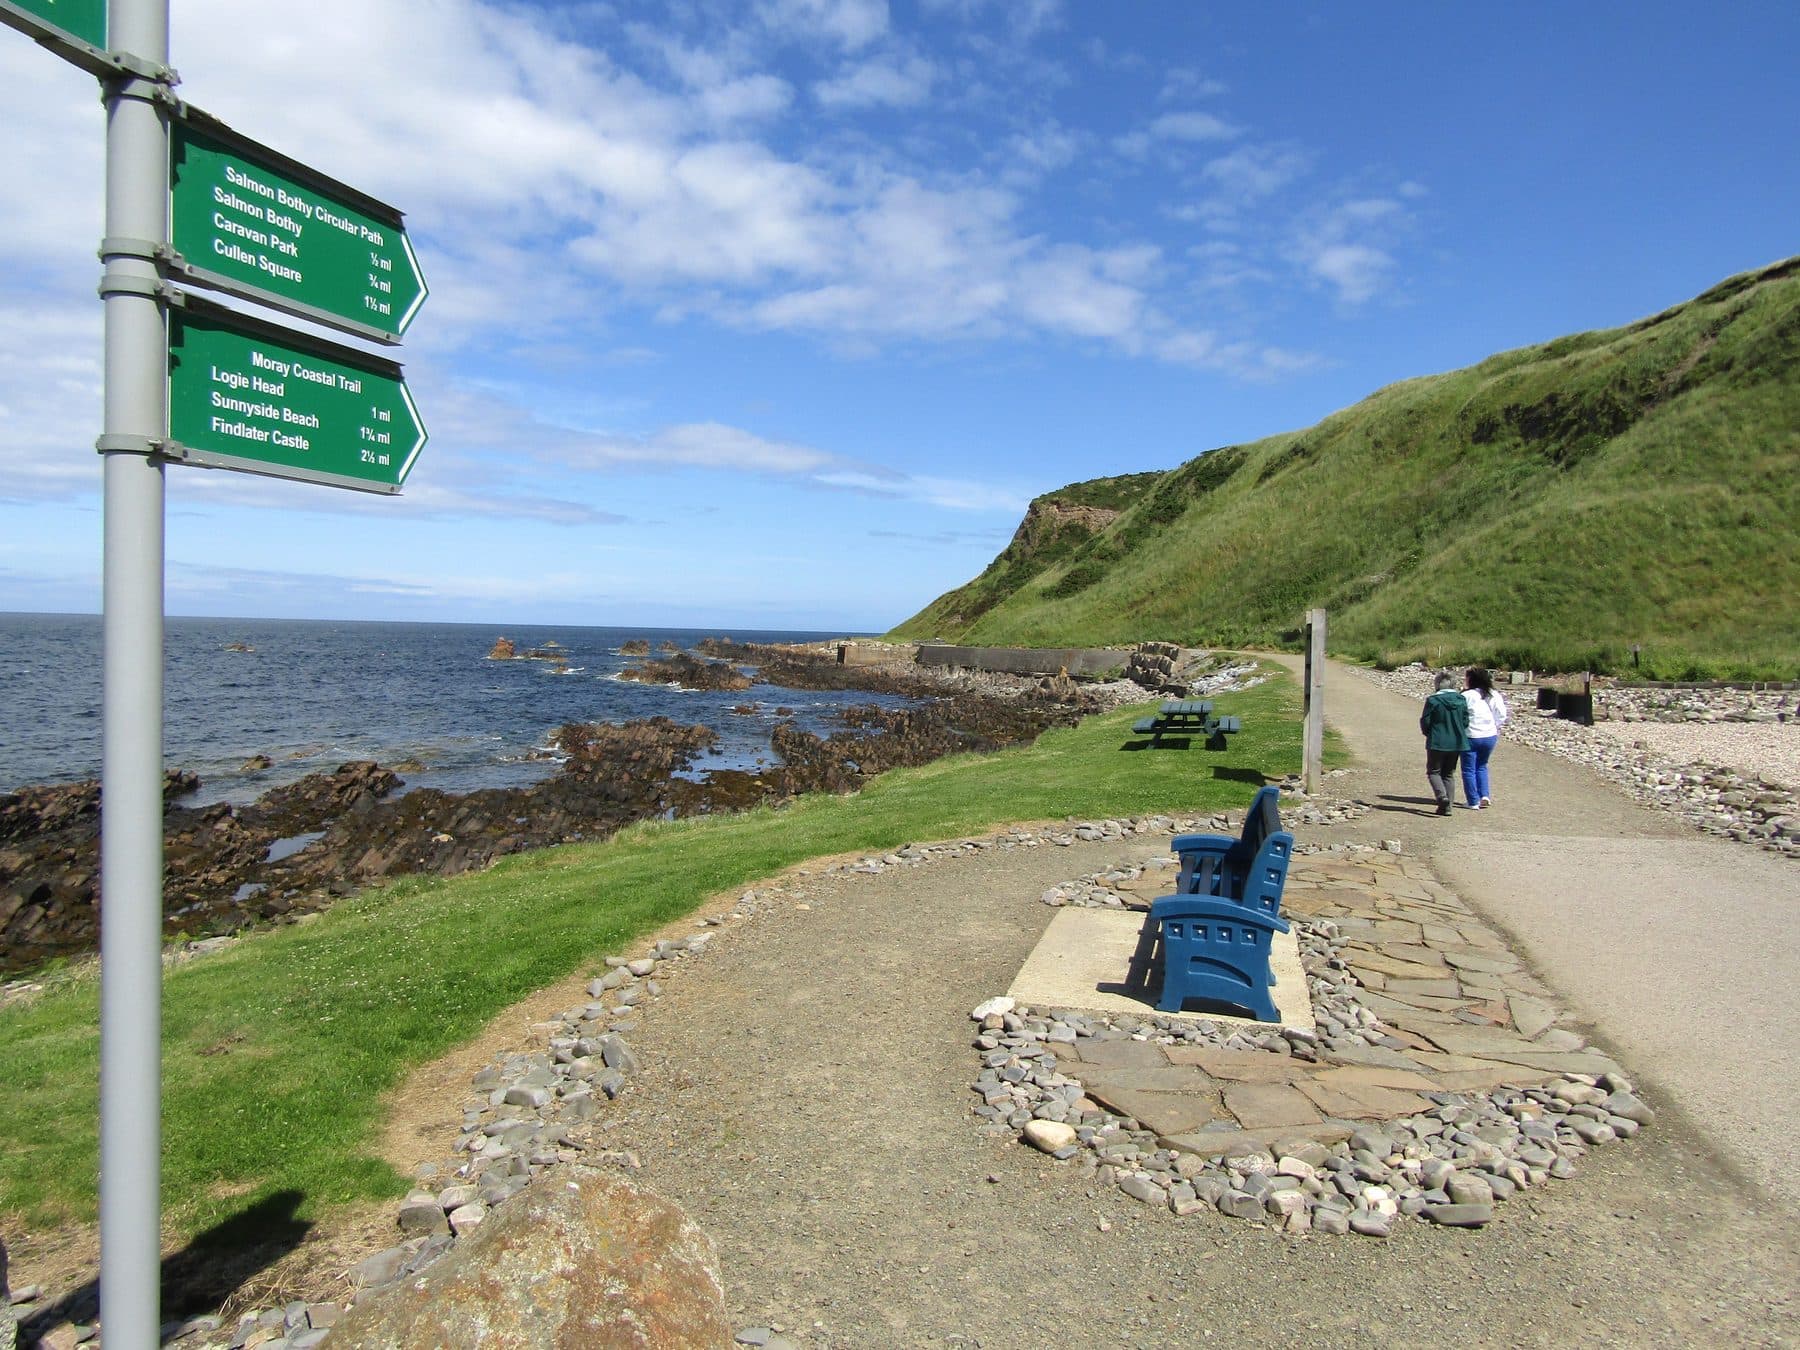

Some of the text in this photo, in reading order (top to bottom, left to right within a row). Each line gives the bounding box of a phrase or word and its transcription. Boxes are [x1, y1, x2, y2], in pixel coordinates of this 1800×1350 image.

[214, 187, 263, 220] Salmon
[267, 208, 302, 238] Bothy
[380, 259, 392, 272] ml
[226, 166, 383, 247] Salmon Bothy Circular Path
[214, 212, 267, 245] Caravan
[271, 236, 298, 258] Park
[379, 280, 391, 293] ml
[214, 238, 256, 267] Cullen
[259, 255, 302, 284] Square
[379, 303, 390, 315] ml
[212, 365, 390, 422] Logie Head 1 ml
[252, 351, 361, 394] Moray Coastal Trail
[212, 392, 280, 421] Sunnyside
[283, 408, 319, 429] Beach
[377, 432, 390, 444] ml
[212, 416, 269, 442] Findlater
[272, 430, 309, 450] Castle
[378, 454, 390, 466] ml
